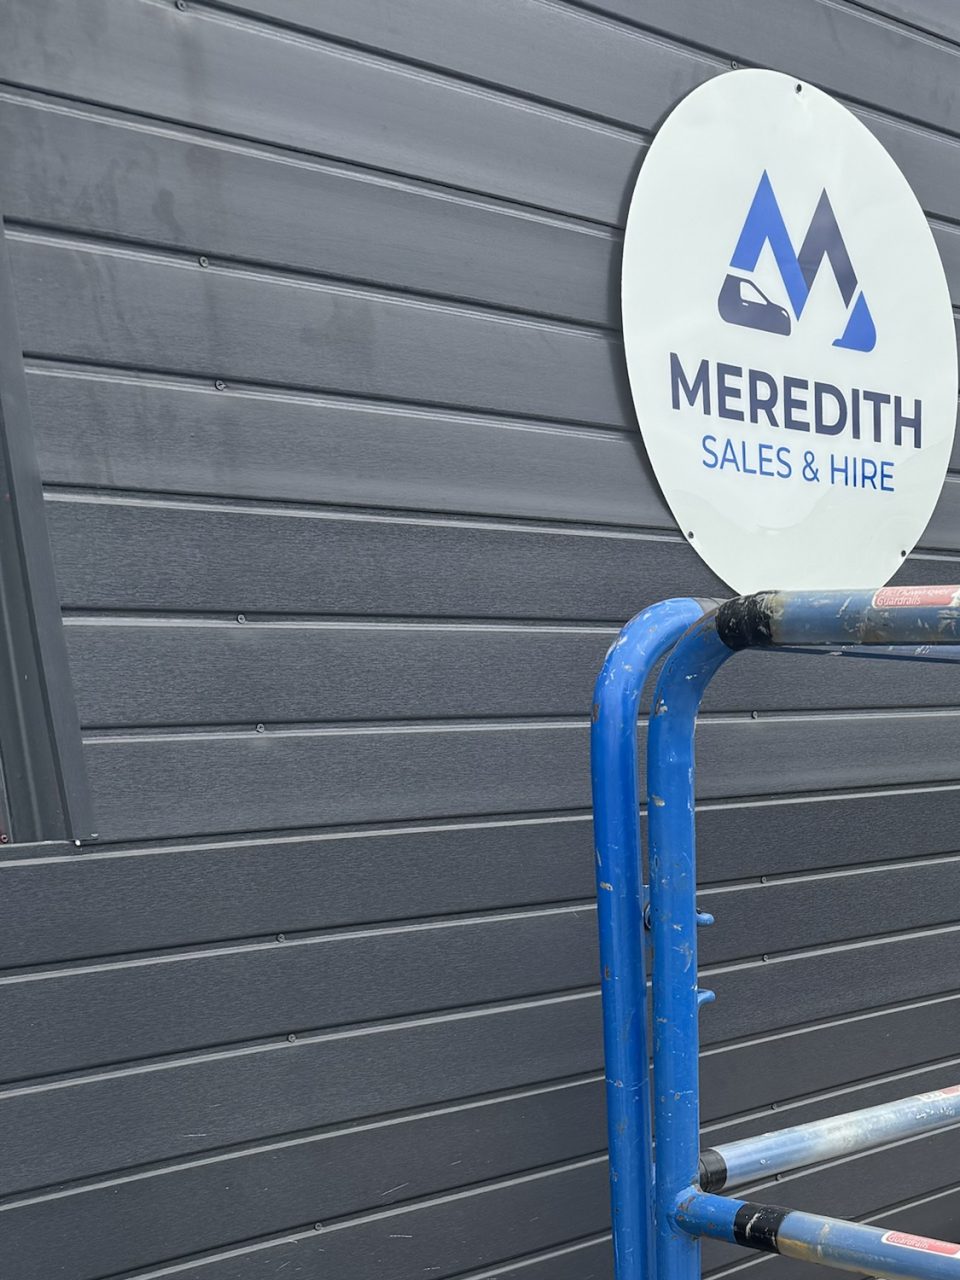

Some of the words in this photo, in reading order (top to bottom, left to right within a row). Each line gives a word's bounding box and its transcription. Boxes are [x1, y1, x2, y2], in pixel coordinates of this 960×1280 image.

[669, 352, 922, 449] MEREDITH
[702, 434, 792, 479] SALES
[802, 451, 820, 483] &
[830, 453, 895, 493] HIRE
